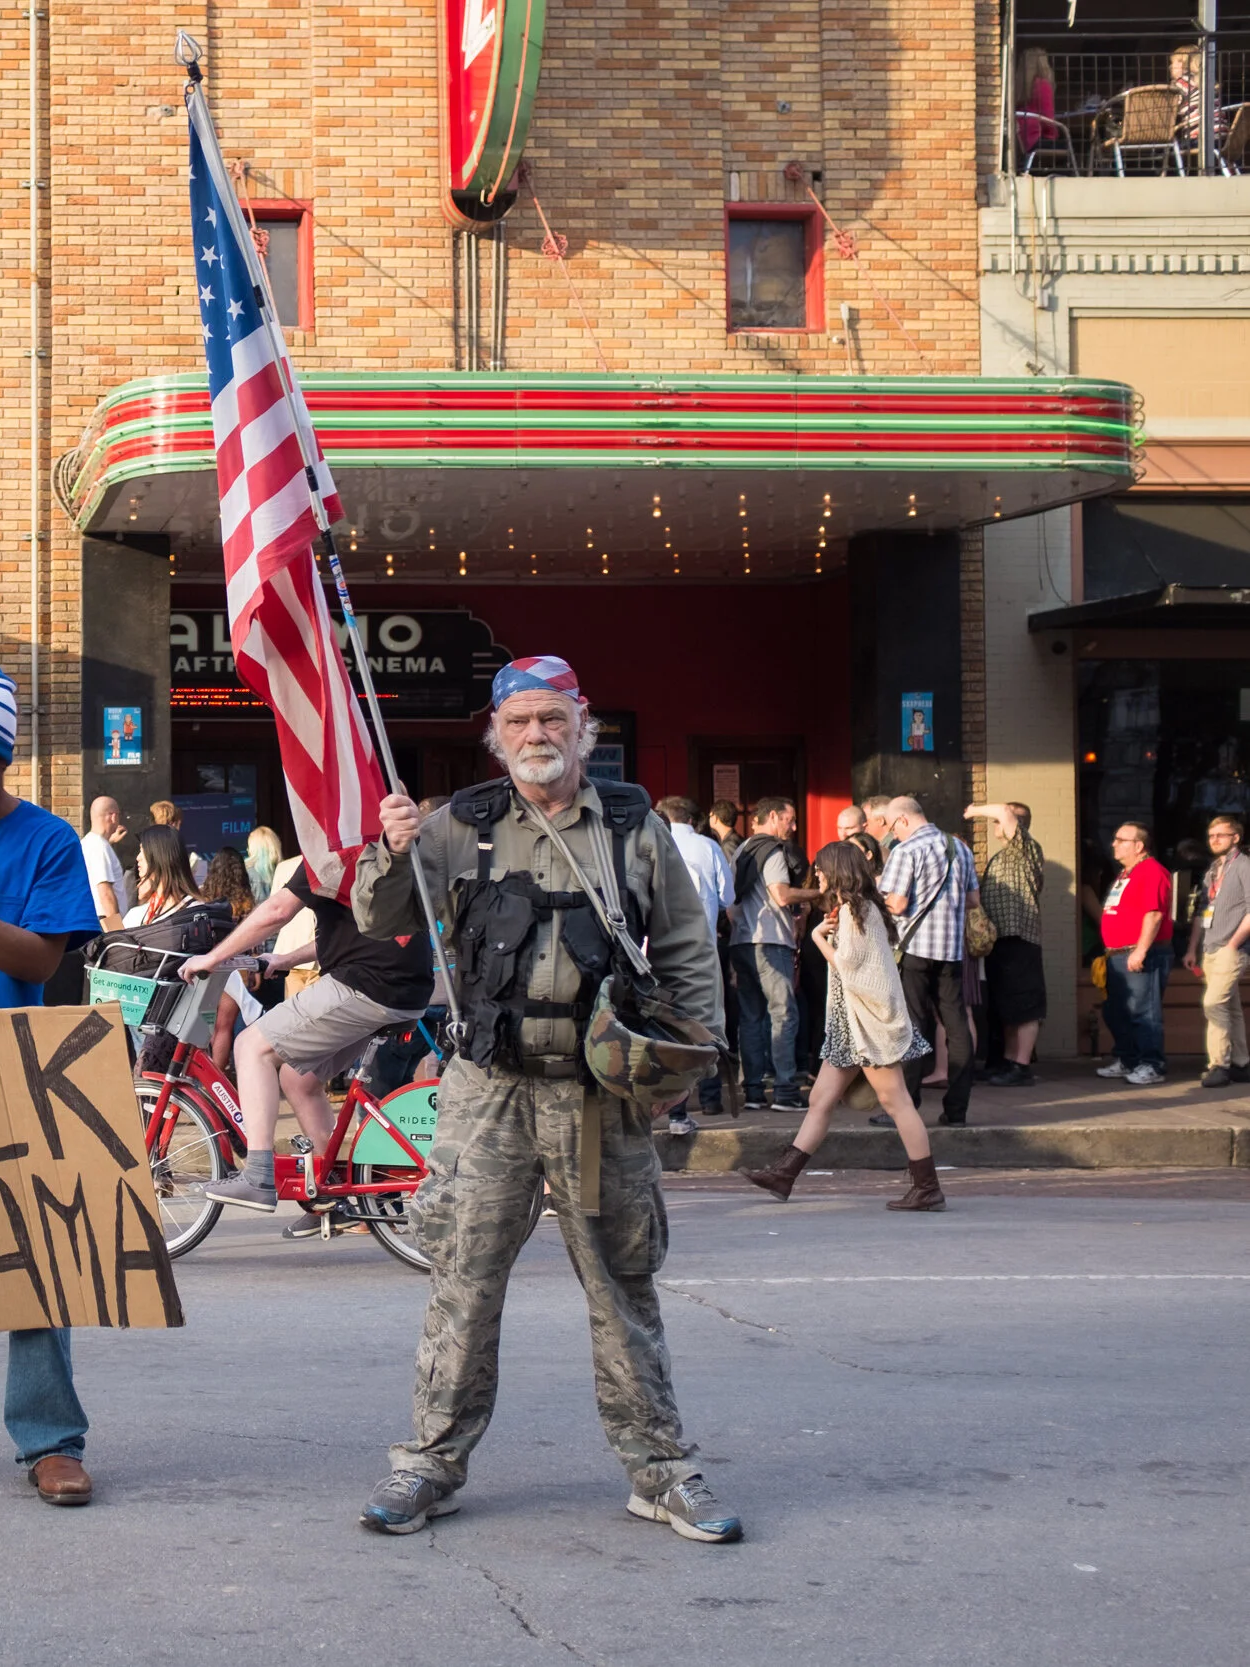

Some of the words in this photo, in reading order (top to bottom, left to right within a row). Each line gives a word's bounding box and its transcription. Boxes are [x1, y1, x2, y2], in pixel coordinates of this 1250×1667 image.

[221, 821, 251, 834] FILM
[93, 977, 105, 985] Get
[106, 981, 132, 991] around
[132, 984, 149, 995] ATX!
[214, 1085, 237, 1112] AUSTIN
[399, 1116, 436, 1125] RIDES
